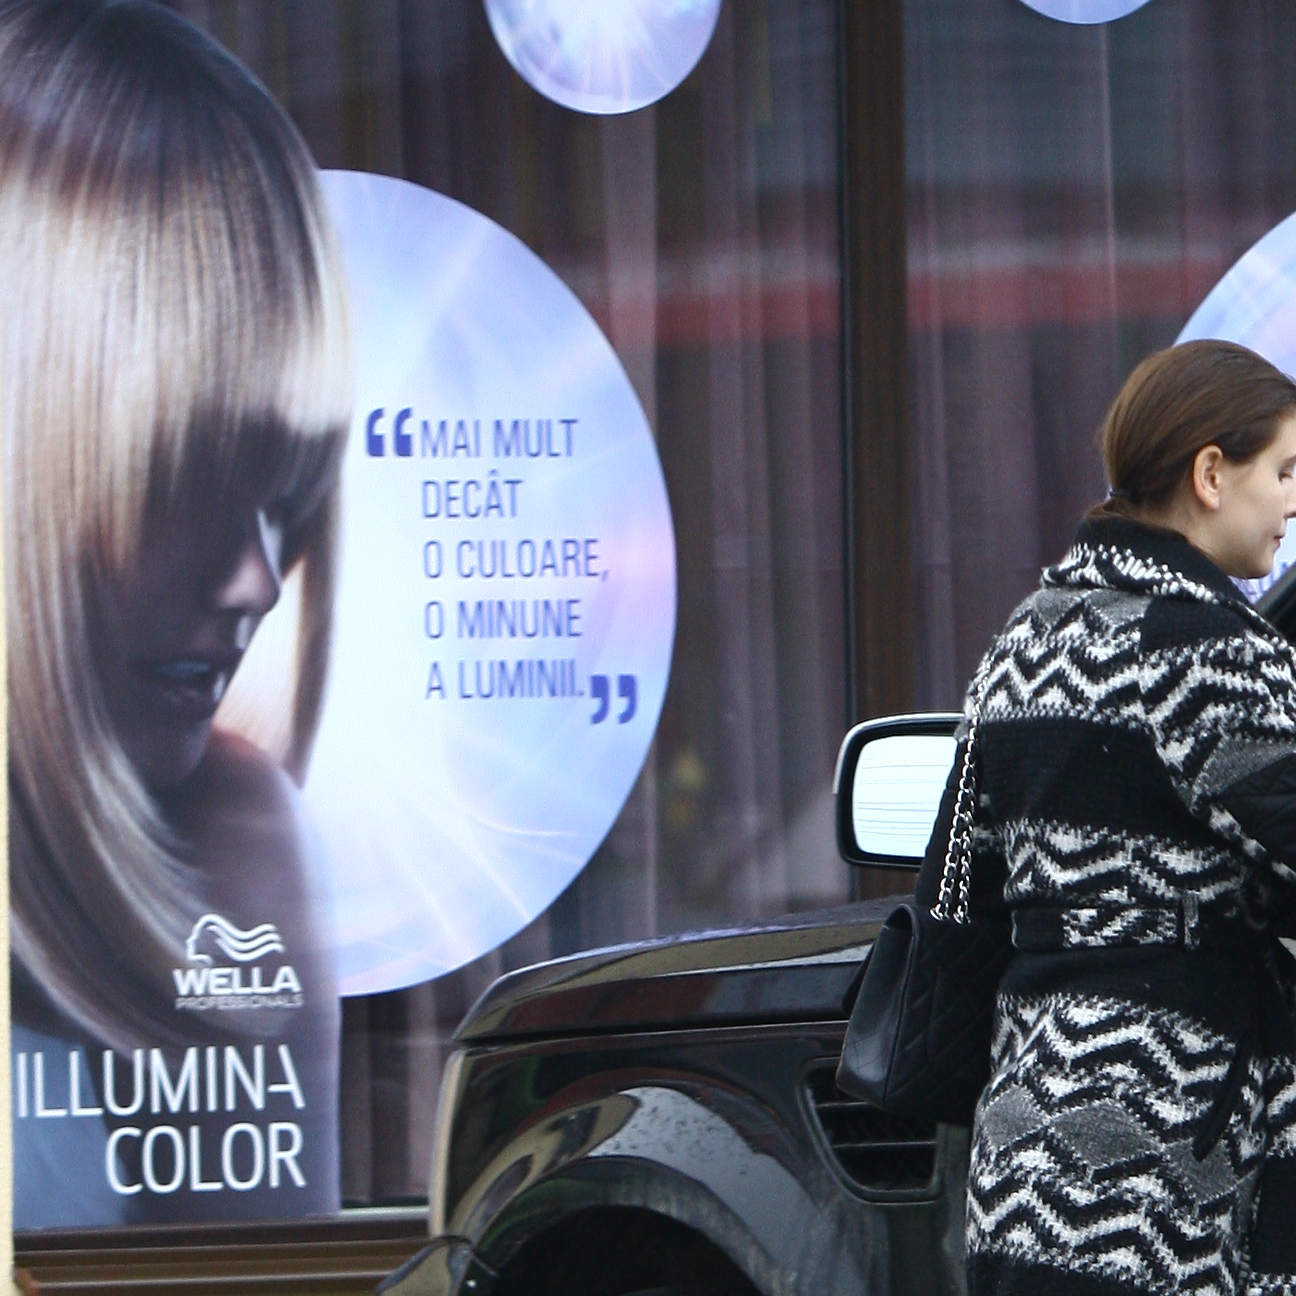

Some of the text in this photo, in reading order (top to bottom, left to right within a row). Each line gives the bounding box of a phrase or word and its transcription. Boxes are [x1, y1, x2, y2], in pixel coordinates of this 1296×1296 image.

[493, 418, 579, 458] MULT
[422, 469, 523, 518] DECÂT
[423, 538, 610, 582] O CULOARE,
[424, 599, 582, 639] O MINUNE
[425, 661, 447, 700] A
[172, 966, 303, 996] WELLA
[17, 1044, 306, 1118] ILLUMINA
[104, 1122, 307, 1194] COLOR
